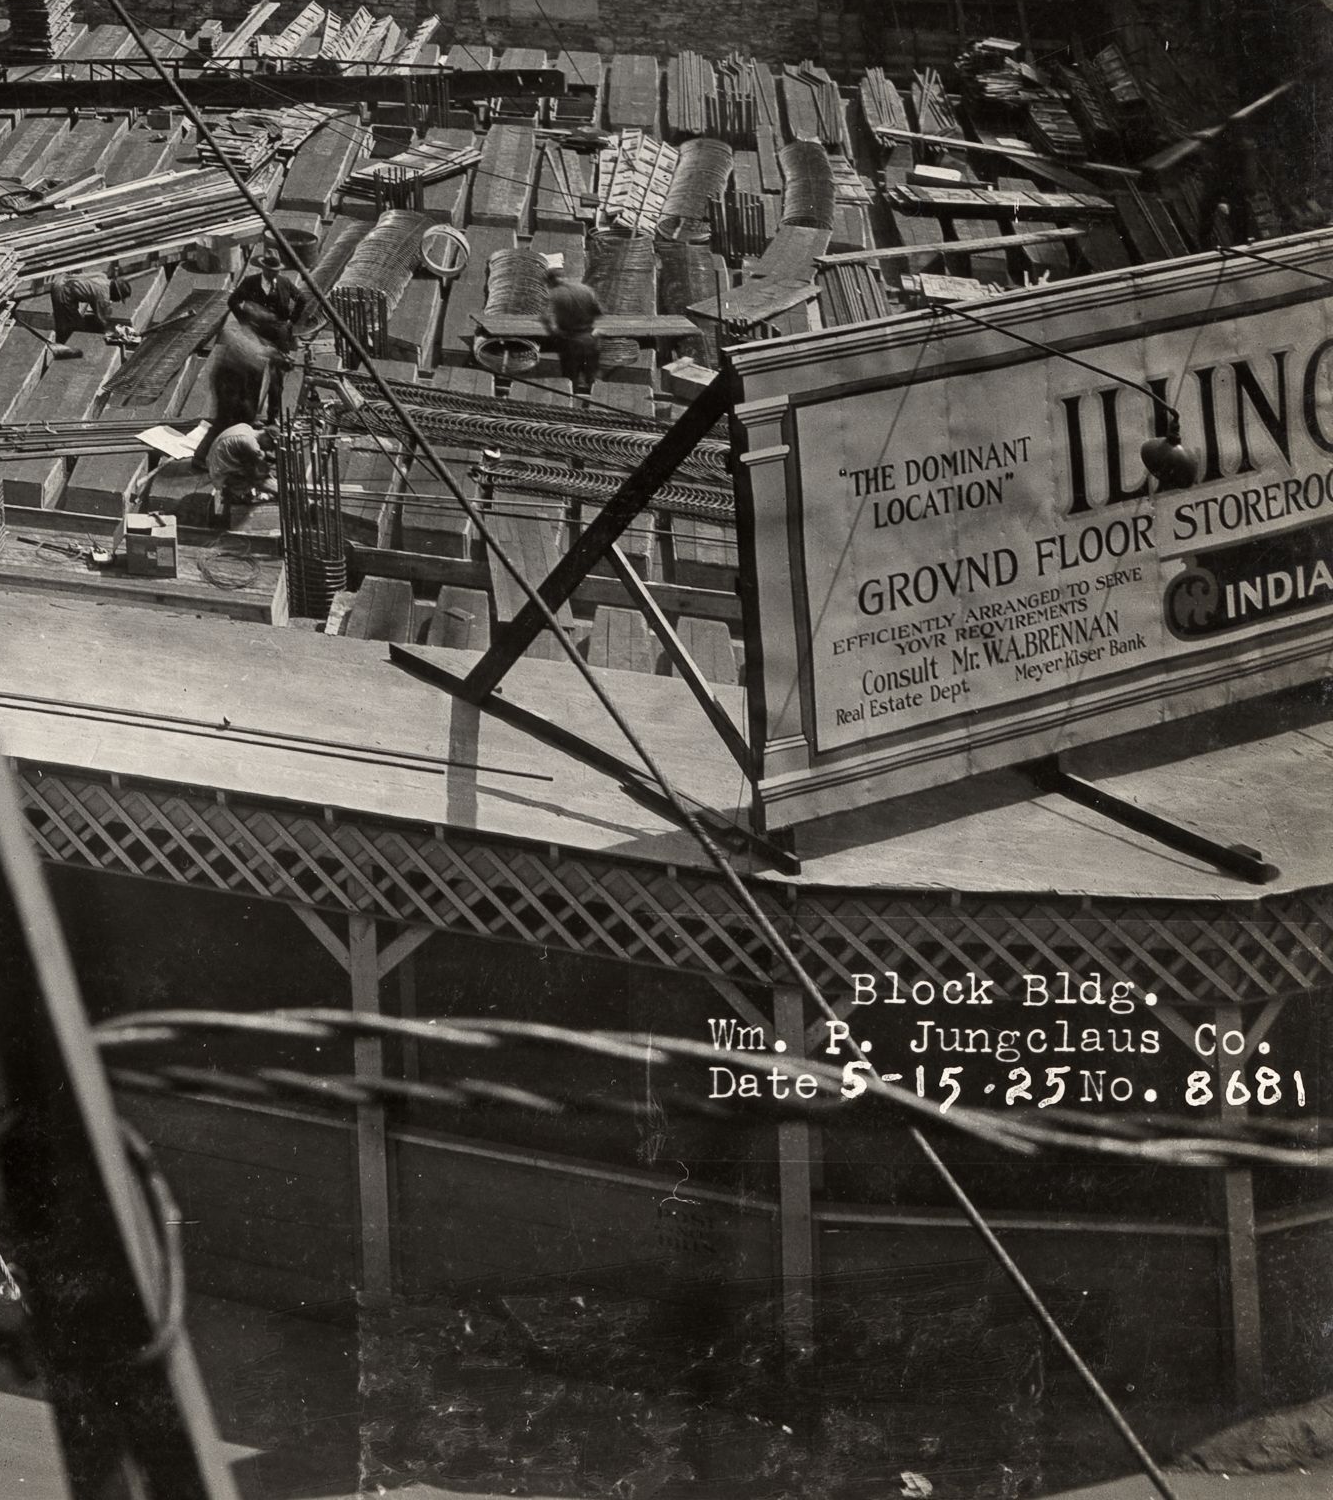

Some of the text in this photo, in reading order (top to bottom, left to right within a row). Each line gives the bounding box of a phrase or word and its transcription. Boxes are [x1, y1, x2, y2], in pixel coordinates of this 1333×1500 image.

[904, 436, 1032, 486] DOMINANT
[873, 471, 1015, 529] LOCATION"
[857, 465, 1333, 616] GROVND FLOOR STORERO
[832, 566, 1143, 656] EFFICIENTLY ARRANGED TO SERVE
[894, 597, 1089, 656] YOVR REQVIREMENTS
[835, 632, 1147, 727] Real Estate Dept. Meyer Kiser Bank
[861, 653, 939, 697] Consult
[951, 645, 981, 676] Mr.
